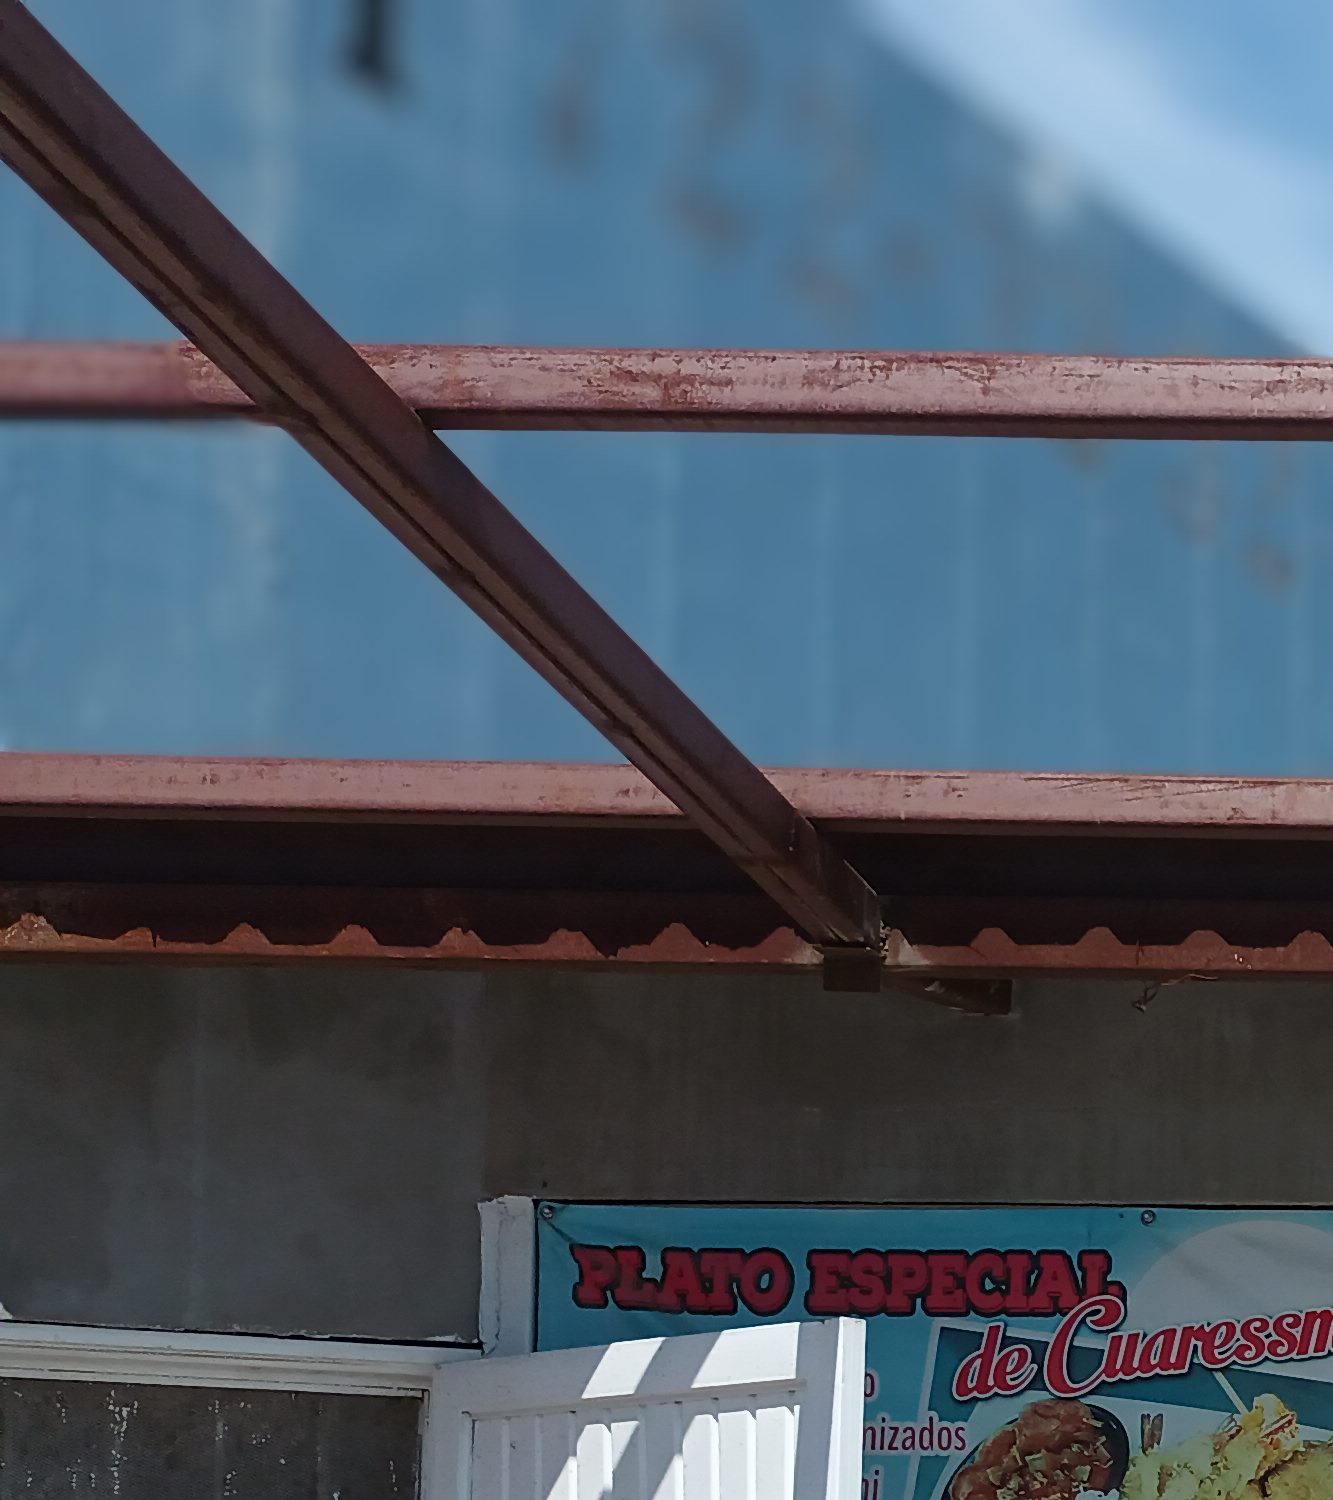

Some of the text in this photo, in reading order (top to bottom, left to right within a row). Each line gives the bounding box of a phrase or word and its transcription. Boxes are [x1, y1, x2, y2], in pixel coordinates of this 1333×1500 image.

[574, 1246, 1125, 1317] PLATO ESPECIAL
[955, 1324, 1035, 1399] de
